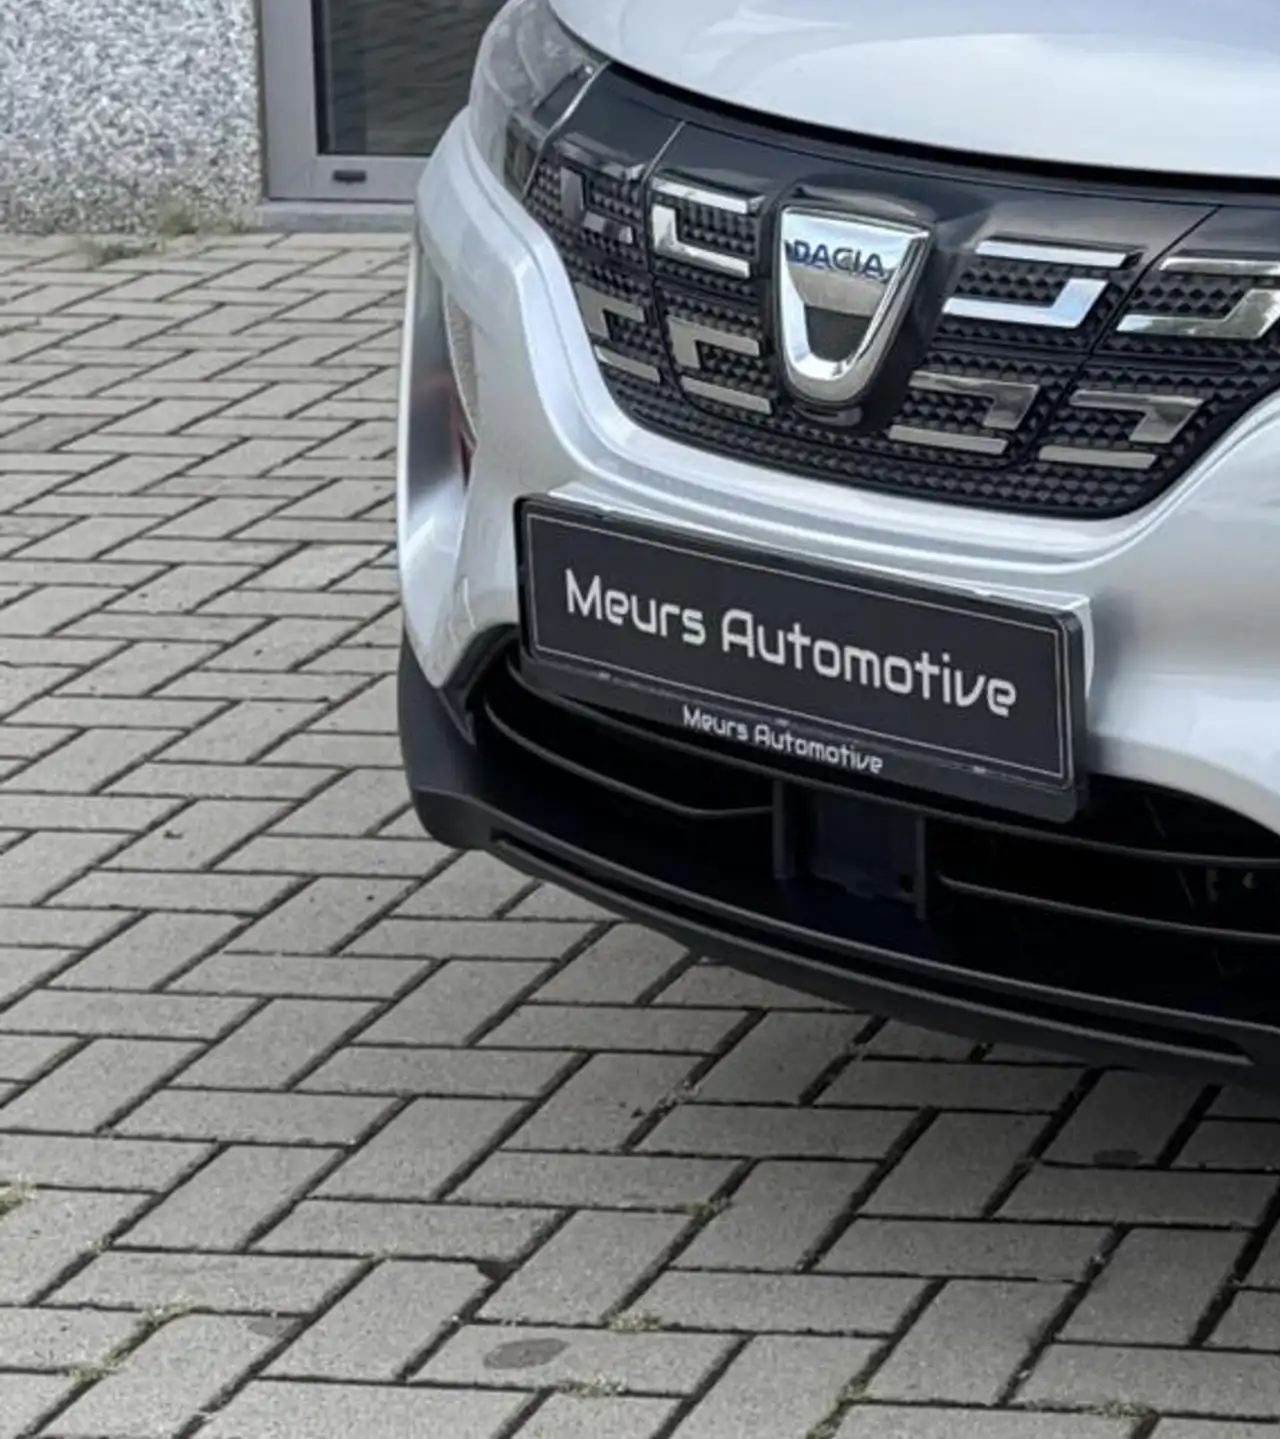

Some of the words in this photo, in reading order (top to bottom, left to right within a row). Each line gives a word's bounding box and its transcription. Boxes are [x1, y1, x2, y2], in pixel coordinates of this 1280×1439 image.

[792, 239, 886, 279] DACIA
[563, 567, 707, 647] Meurs
[720, 607, 1018, 718] Automotive
[681, 702, 749, 743] Meurs
[754, 721, 884, 776] Automotive
